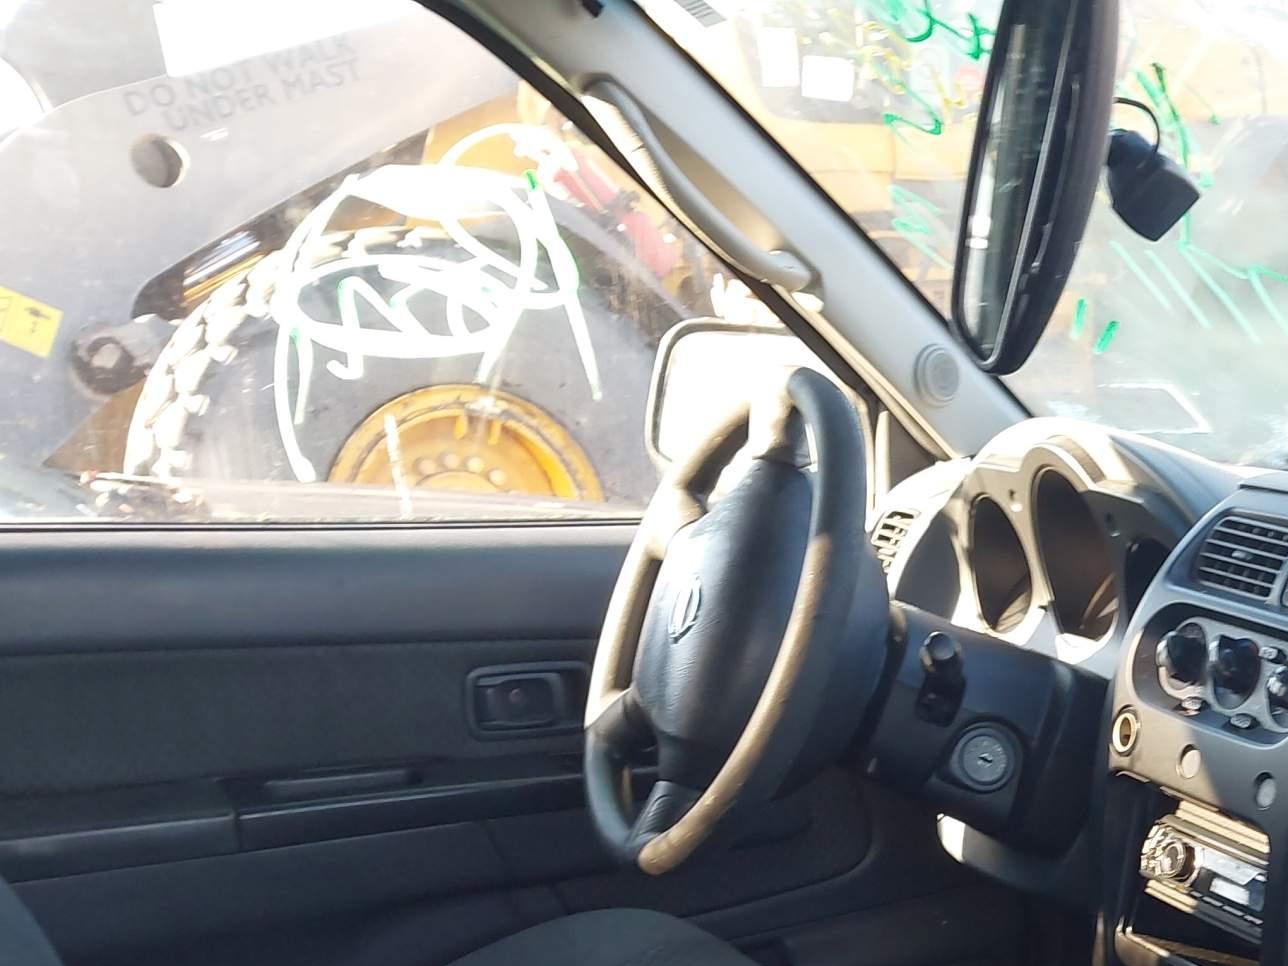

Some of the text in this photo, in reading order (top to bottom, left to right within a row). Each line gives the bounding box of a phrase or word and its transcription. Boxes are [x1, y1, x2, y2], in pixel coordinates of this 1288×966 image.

[123, 35, 357, 116] DO NOT WALK
[161, 57, 361, 131] UNDER MAST
